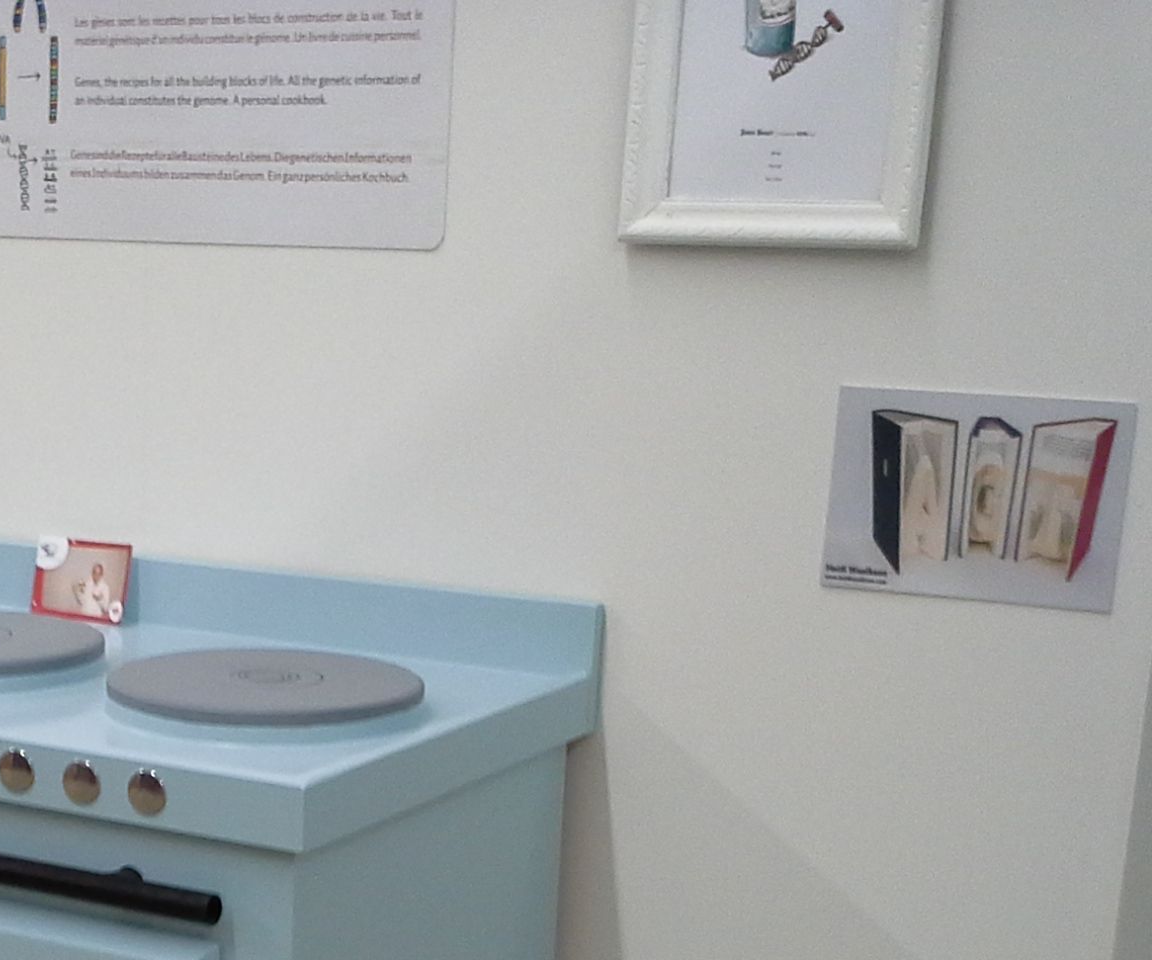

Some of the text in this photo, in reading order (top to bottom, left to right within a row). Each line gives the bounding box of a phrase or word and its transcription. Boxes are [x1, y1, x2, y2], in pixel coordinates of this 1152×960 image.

[104, 76, 118, 87] the
[164, 75, 175, 87] all
[176, 75, 190, 87] the
[192, 75, 227, 89] building
[229, 75, 257, 86] blocks
[259, 75, 268, 86] of
[287, 74, 300, 86] All
[302, 74, 318, 86] the
[319, 75, 352, 89] genetic
[354, 73, 410, 85] information
[411, 73, 421, 85] of
[86, 94, 127, 106] individual
[128, 94, 176, 106] constitutes
[177, 94, 191, 106] the
[233, 94, 240, 105] A
[241, 94, 280, 107] personal
